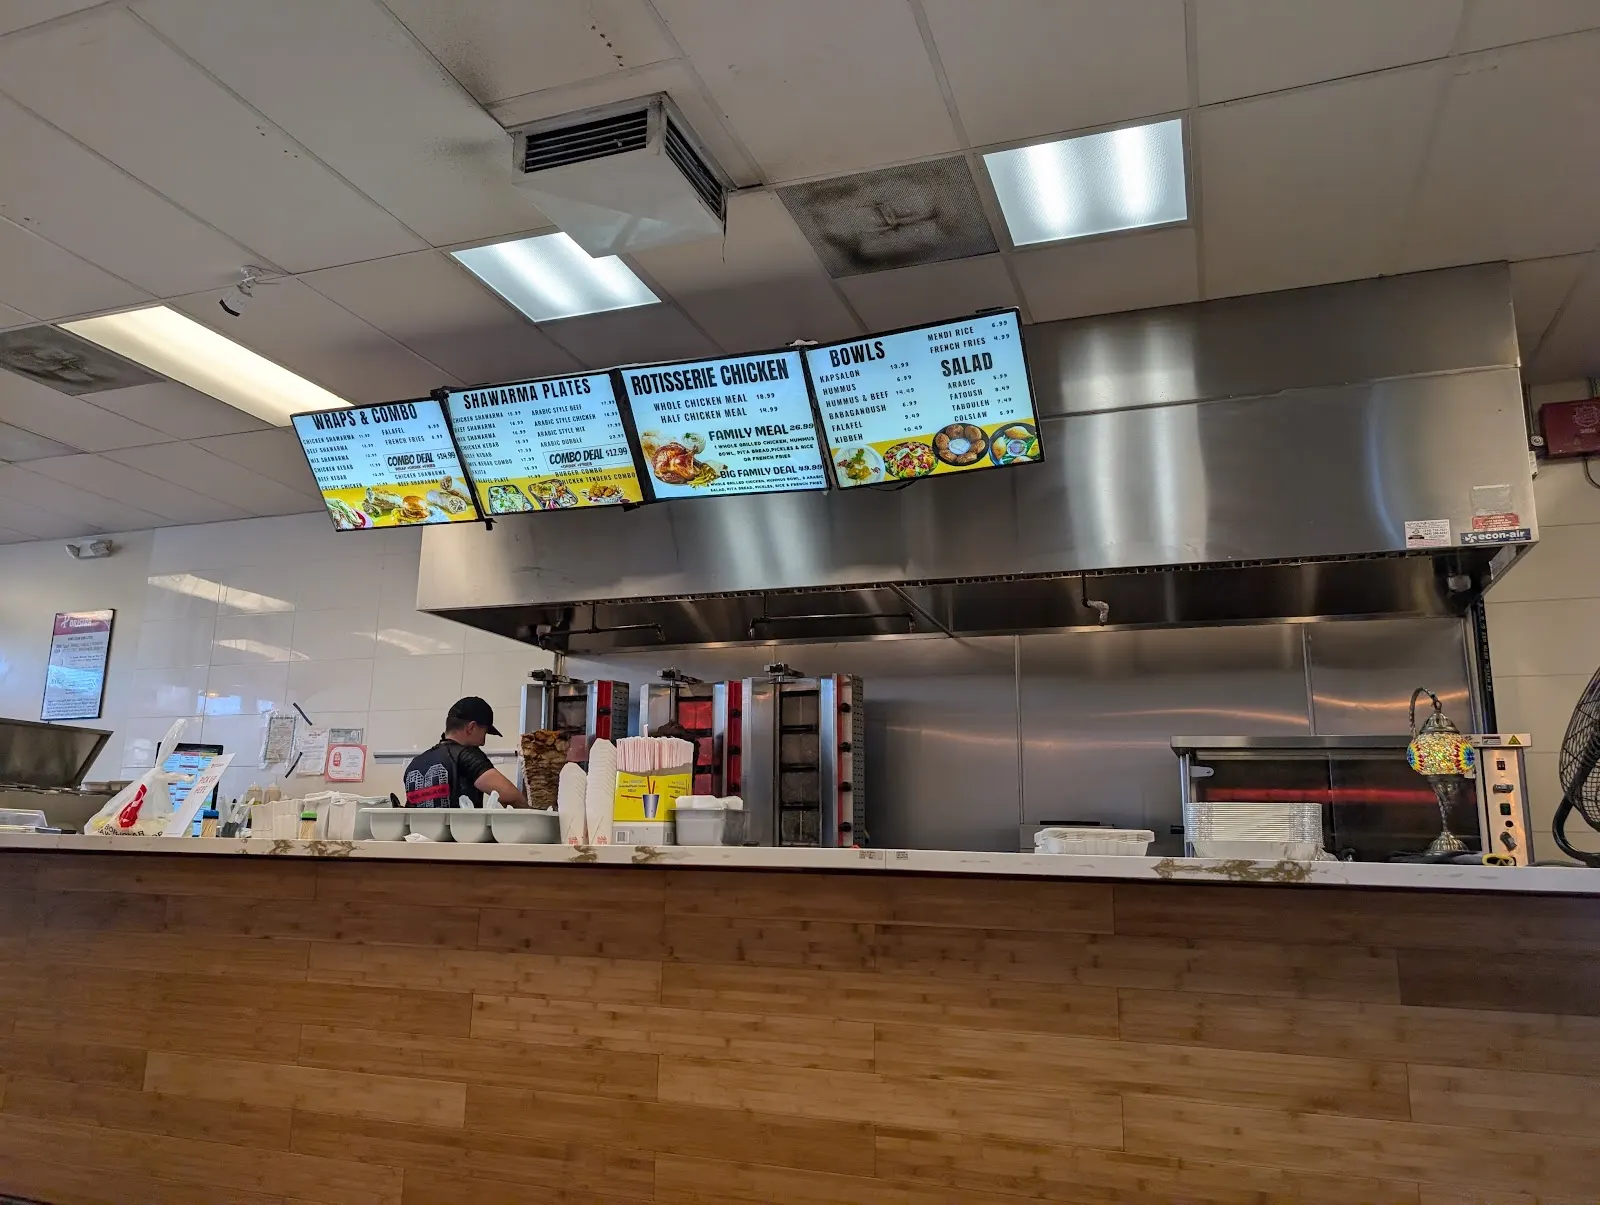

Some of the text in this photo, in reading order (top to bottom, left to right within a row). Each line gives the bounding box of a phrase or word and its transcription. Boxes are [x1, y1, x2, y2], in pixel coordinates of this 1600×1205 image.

[927, 320, 1008, 342] MENDI RICE 6.99
[930, 342, 960, 354] FRENCH
[963, 337, 986, 348] FRIES
[829, 341, 885, 368] BOWLS
[940, 352, 993, 377] SALAD
[630, 359, 789, 396] ROTISSERIE CHICKEN
[820, 369, 860, 383] KAPSALON
[822, 384, 857, 396] HUMMUS
[948, 379, 976, 389] ARABIC
[463, 378, 591, 410] SHAWARMA PLATES
[826, 396, 860, 408] HUMMUS
[870, 391, 889, 401] BEEF
[950, 389, 983, 400] FATOUSH
[653, 401, 681, 411] WHOLE
[685, 396, 722, 408] CHICKEN
[725, 393, 748, 404] MEAL
[952, 399, 990, 411] TABOULEH
[312, 404, 418, 430] WRAPS & COMBO
[475, 412, 503, 421] SHAWARMA
[532, 408, 552, 416] ARABIC
[661, 414, 681, 424] HALF
[684, 410, 722, 422] CHICKEN
[724, 408, 747, 418] MEAL
[829, 404, 887, 420] BABAGANOUSH
[954, 411, 987, 422] COLSLAW
[534, 419, 555, 427] ARABIC
[556, 416, 571, 424] STYLE
[572, 413, 597, 422] CHICKEN
[832, 421, 863, 432] FALAFEL
[381, 427, 405, 435] FALAFEL
[708, 427, 752, 441] FAMILY
[755, 424, 789, 437] MEAL
[302, 437, 324, 445] CHICKEN
[835, 433, 864, 444] KIBBEH
[388, 455, 414, 466] COMBO
[416, 453, 435, 464] DEAL
[549, 451, 582, 465] COMBO
[583, 448, 604, 461] DEAL
[605, 447, 628, 457] $12.99
[555, 469, 580, 477] BURGER
[613, 472, 636, 480] COMBO
[720, 470, 736, 478] BIG
[738, 467, 771, 477] FAMILY
[773, 466, 797, 475] DEAL
[1478, 530, 1524, 540] econ-air
